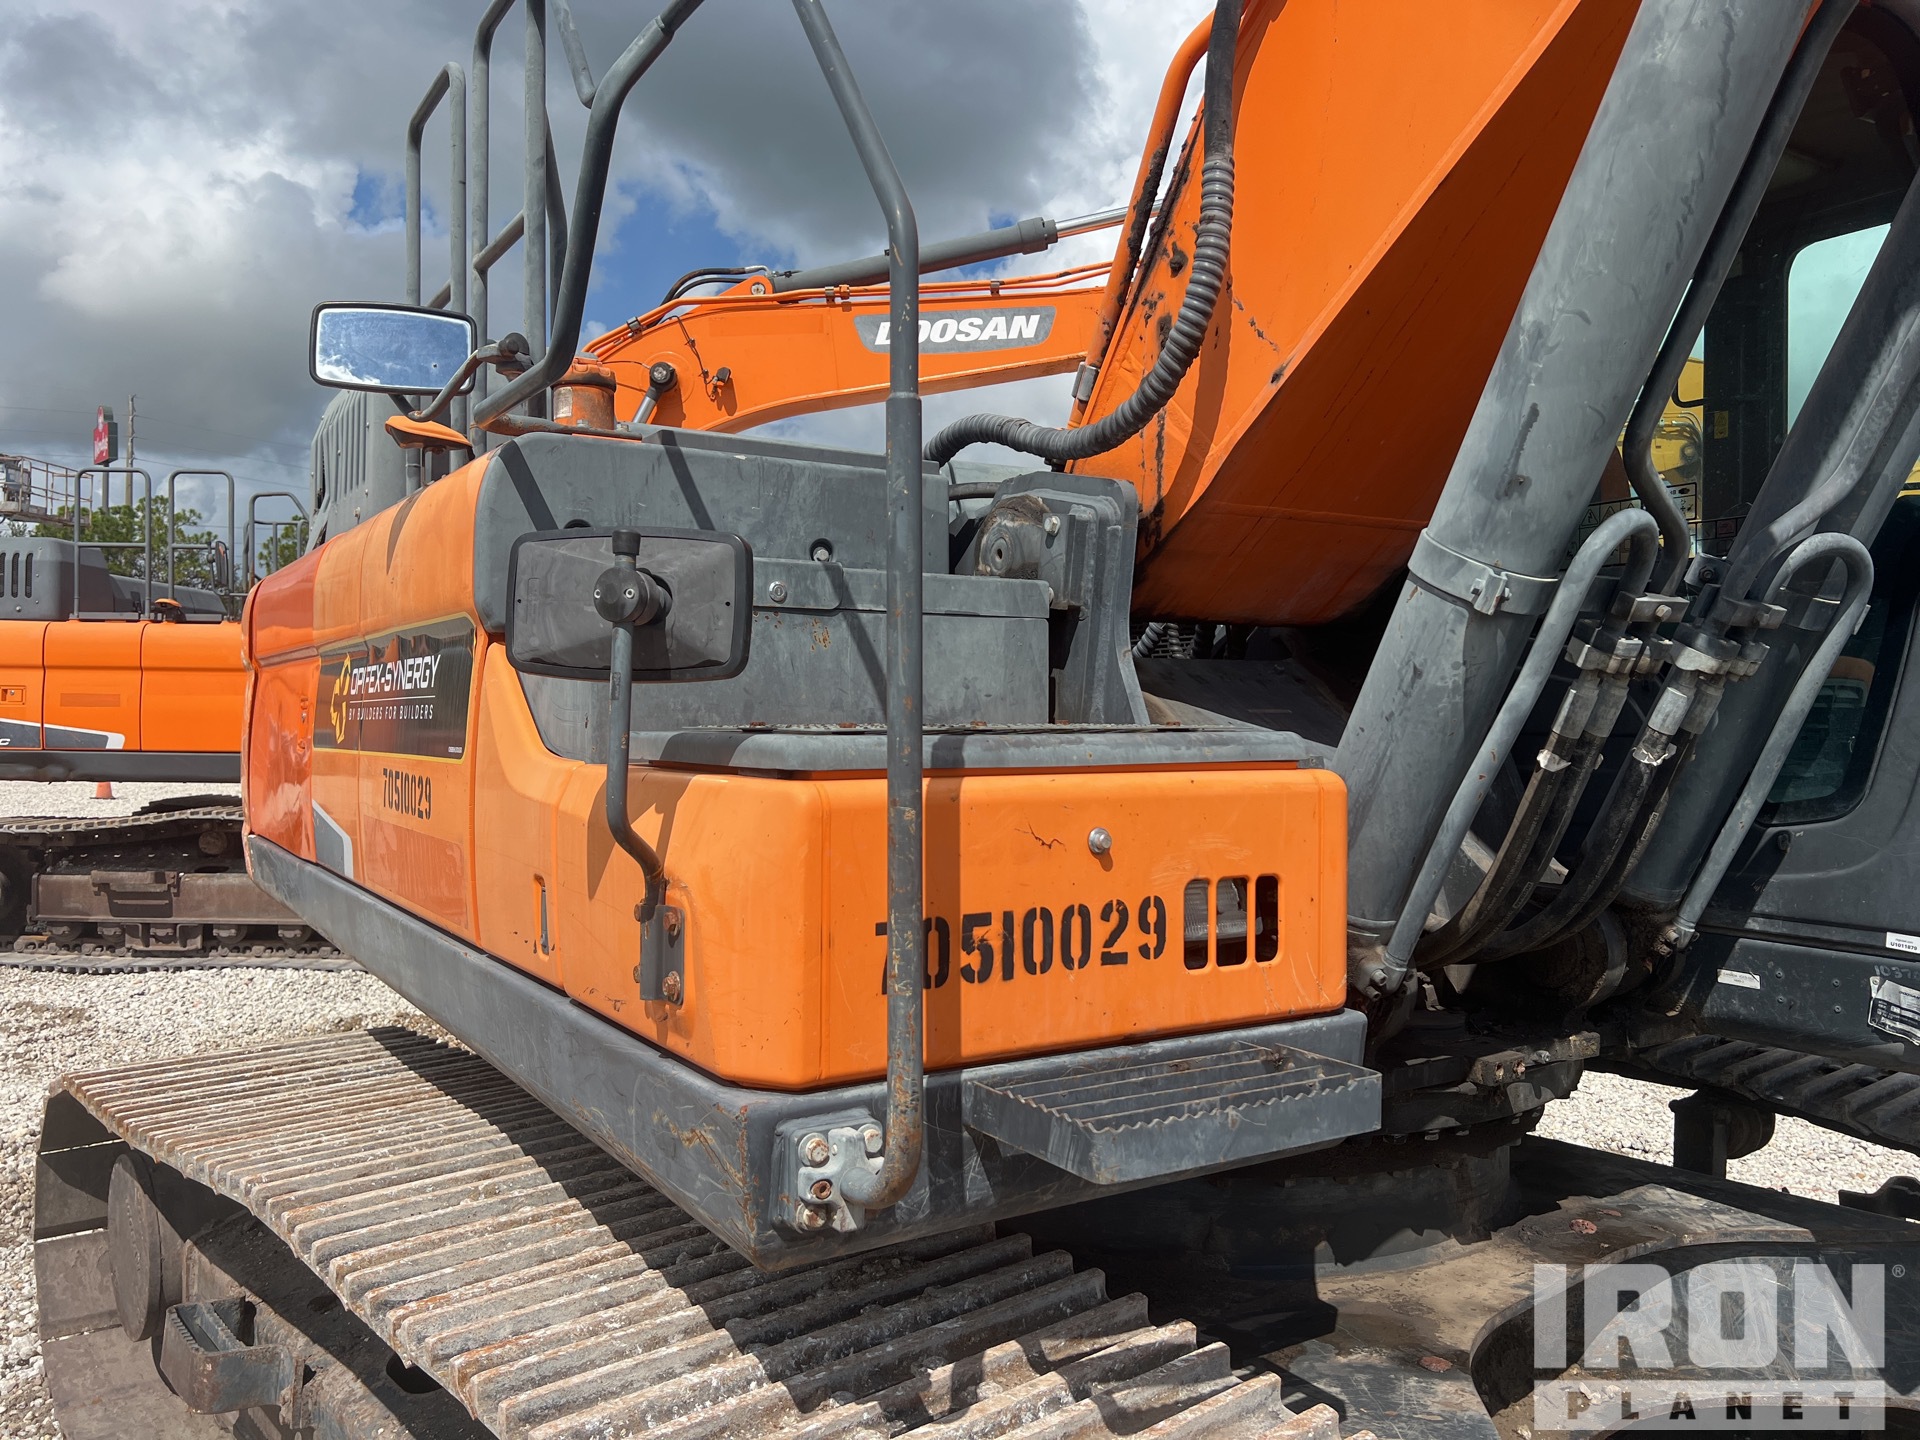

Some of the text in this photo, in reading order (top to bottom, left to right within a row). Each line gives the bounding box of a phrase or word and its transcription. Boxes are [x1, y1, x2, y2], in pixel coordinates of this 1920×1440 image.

[349, 704, 434, 720] BY BUILDERS FOR BUILDERS
[383, 767, 431, 820] 70510029
